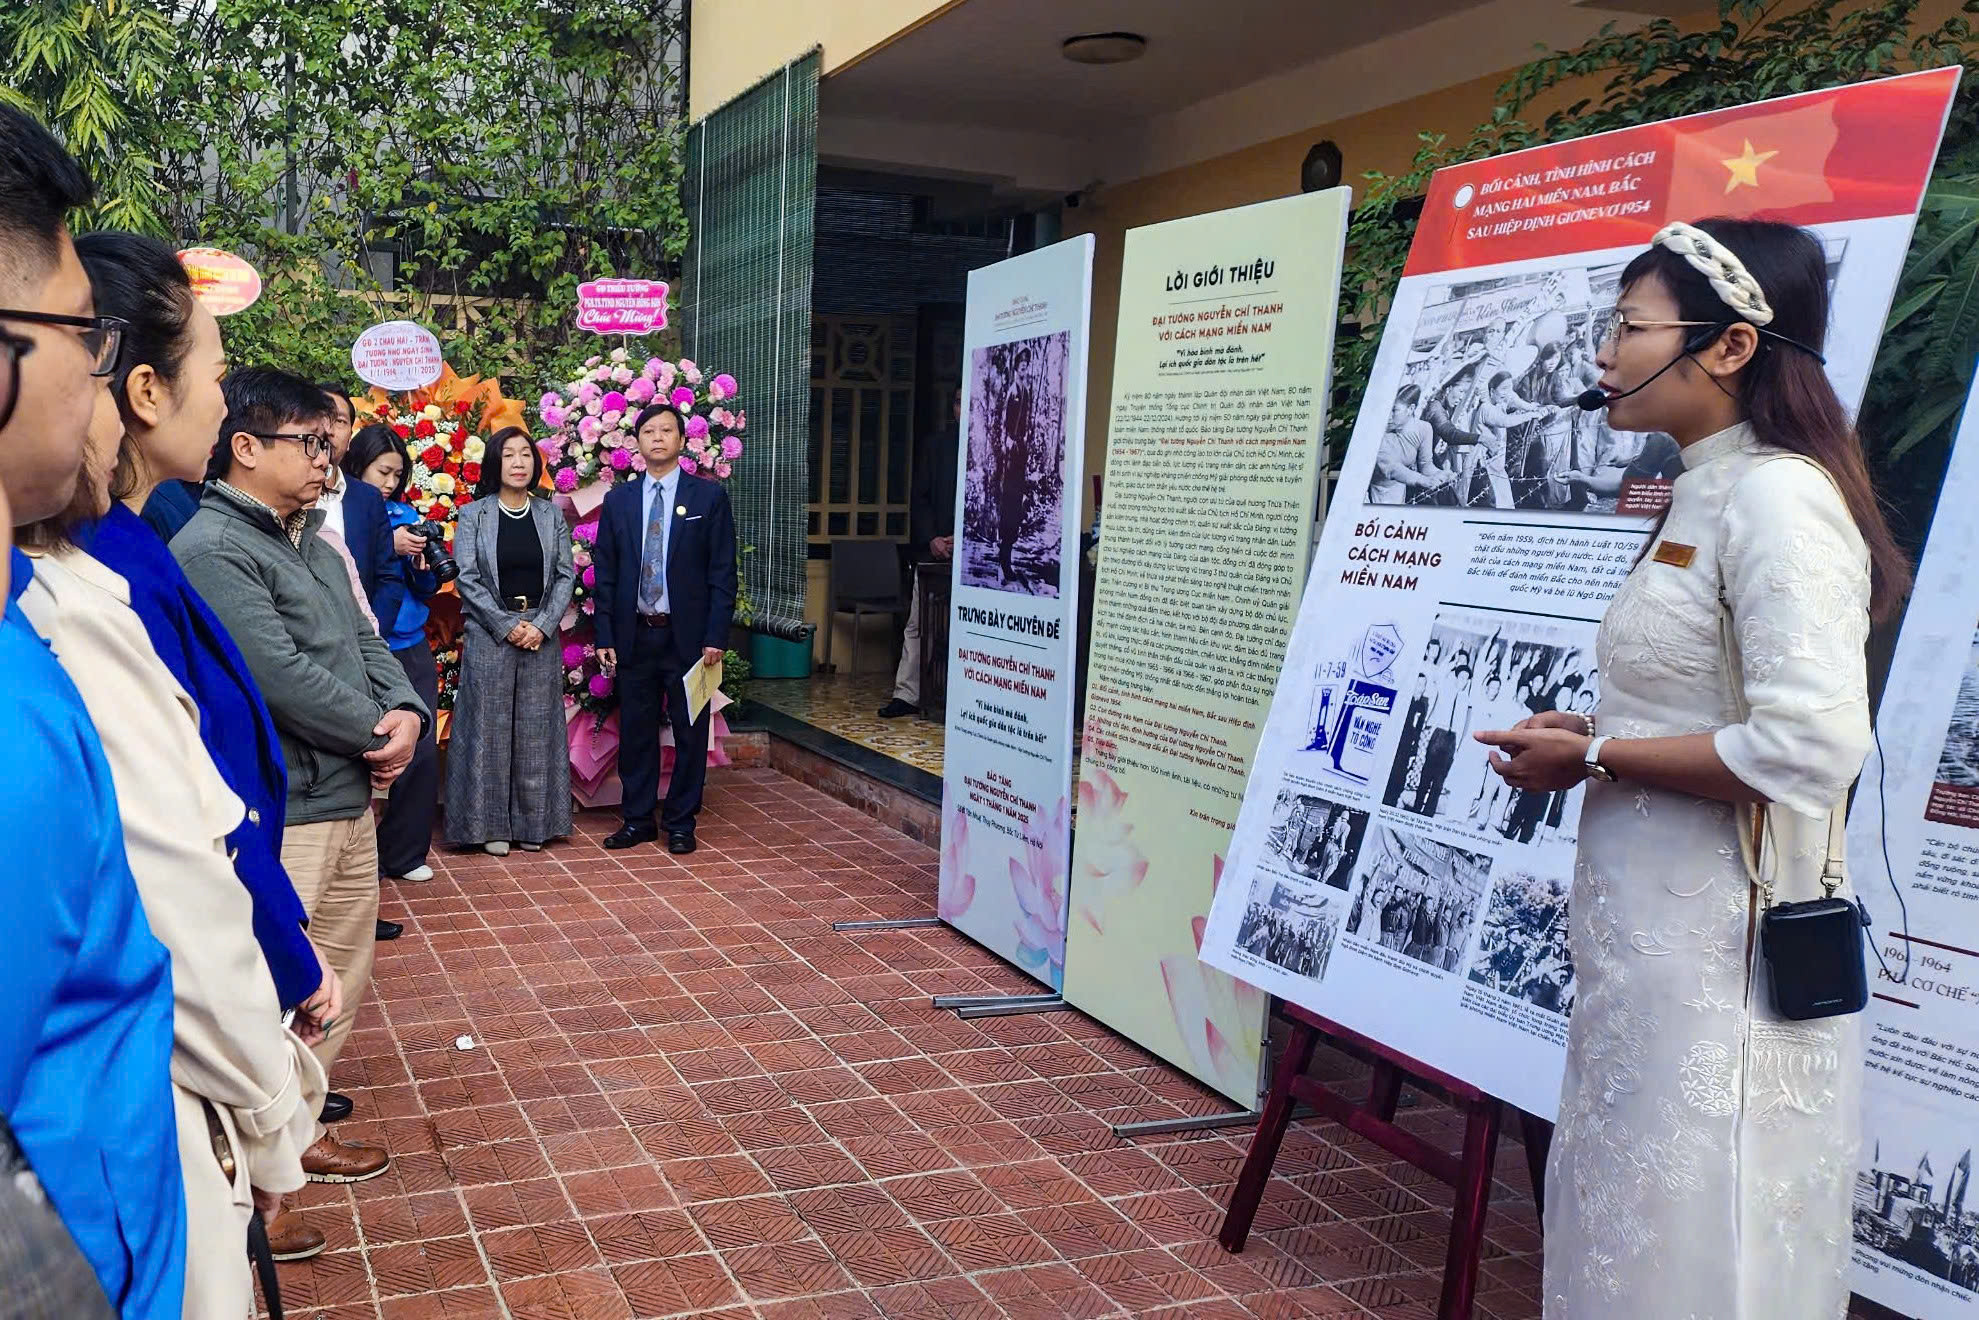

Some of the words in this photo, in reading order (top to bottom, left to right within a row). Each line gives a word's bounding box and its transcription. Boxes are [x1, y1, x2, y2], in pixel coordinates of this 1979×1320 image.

[1480, 180, 1502, 196] BỐI
[1544, 166, 1576, 182] TÌNH
[1577, 160, 1612, 177] HÌNH
[1612, 151, 1656, 170] CÁCH
[1473, 200, 1510, 217] MẠNG
[1511, 196, 1536, 211] HAI
[1537, 187, 1570, 206] MIỀN
[1608, 174, 1642, 194] BẮC
[1467, 223, 1494, 240] SAU
[1492, 217, 1522, 236] HIỆP
[1523, 213, 1555, 232] ĐỊNH
[1620, 199, 1652, 217] 1954
[1166, 270, 1188, 291] LỜI
[1193, 265, 1224, 288] GIỚI
[1229, 257, 1275, 285] THIỆU
[584, 309, 611, 323] Chúc
[1153, 316, 1166, 327] ĐẠI
[1198, 304, 1232, 322] NGUYỄN
[1234, 304, 1251, 318] CHÍ
[1253, 303, 1283, 317] THANH
[1159, 330, 1172, 342] VỚI
[1174, 327, 1196, 341] CÁCH
[1198, 326, 1223, 341] MẠNG
[1226, 319, 1248, 336] MIỀN
[1251, 321, 1272, 333] NAM
[1354, 516, 1380, 538] BỐI
[1384, 520, 1429, 541] CẢNH
[1498, 534, 1513, 542] năm
[1570, 538, 1590, 548] hành
[1592, 540, 1612, 550] Luật
[1614, 542, 1640, 550] 10/59
[1348, 544, 1390, 563] CÁCH
[1393, 550, 1442, 569] MẠNG
[1502, 558, 1522, 567] cách
[1522, 560, 1544, 570] mạng
[1546, 562, 1566, 571] miền
[1555, 550, 1570, 560] yêu
[1597, 554, 1613, 562] Lúc
[1340, 564, 1378, 587] MIỀN
[1381, 573, 1419, 592] NAM
[1568, 576, 1583, 585] cho
[1584, 578, 1601, 588] nên
[1510, 584, 1530, 594] quốc
[1577, 590, 1595, 600] Ngô
[958, 605, 987, 626] TRƯNG
[988, 608, 1006, 629] BÀY
[1007, 614, 1045, 638] CHUYÊN
[1046, 617, 1061, 640] ĐỀ
[958, 648, 968, 662] ĐẠI
[970, 650, 991, 667] TƯỚNG
[992, 654, 1018, 673] NGUYỄN
[1018, 661, 1030, 676] CHÍ
[1032, 665, 1056, 682] THANH
[976, 670, 992, 686] CÁCH
[994, 675, 1012, 692] MẠNG
[1014, 679, 1030, 696] MIỀN
[1030, 684, 1047, 701] NAM
[1884, 946, 1908, 962] 196
[1920, 956, 1952, 973] 1964
[1878, 968, 1907, 986] PH
